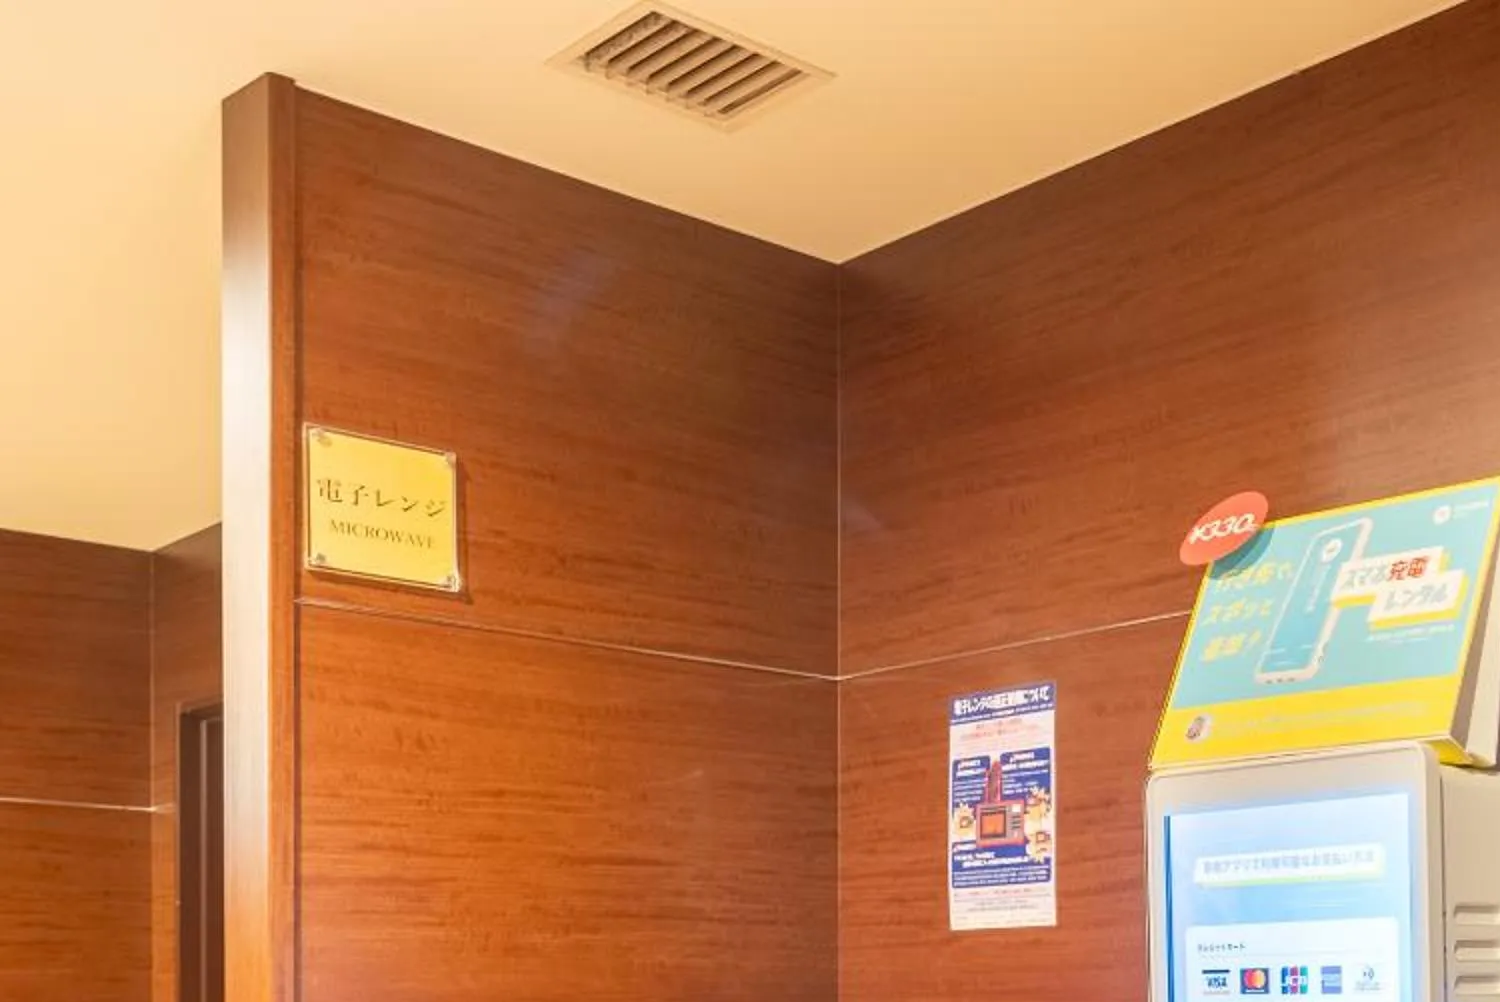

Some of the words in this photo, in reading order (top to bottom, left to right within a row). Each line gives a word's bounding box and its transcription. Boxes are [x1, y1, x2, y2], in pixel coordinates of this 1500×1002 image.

[317, 479, 448, 518] 電子レンジ
[330, 519, 436, 549] MICROWAVE
